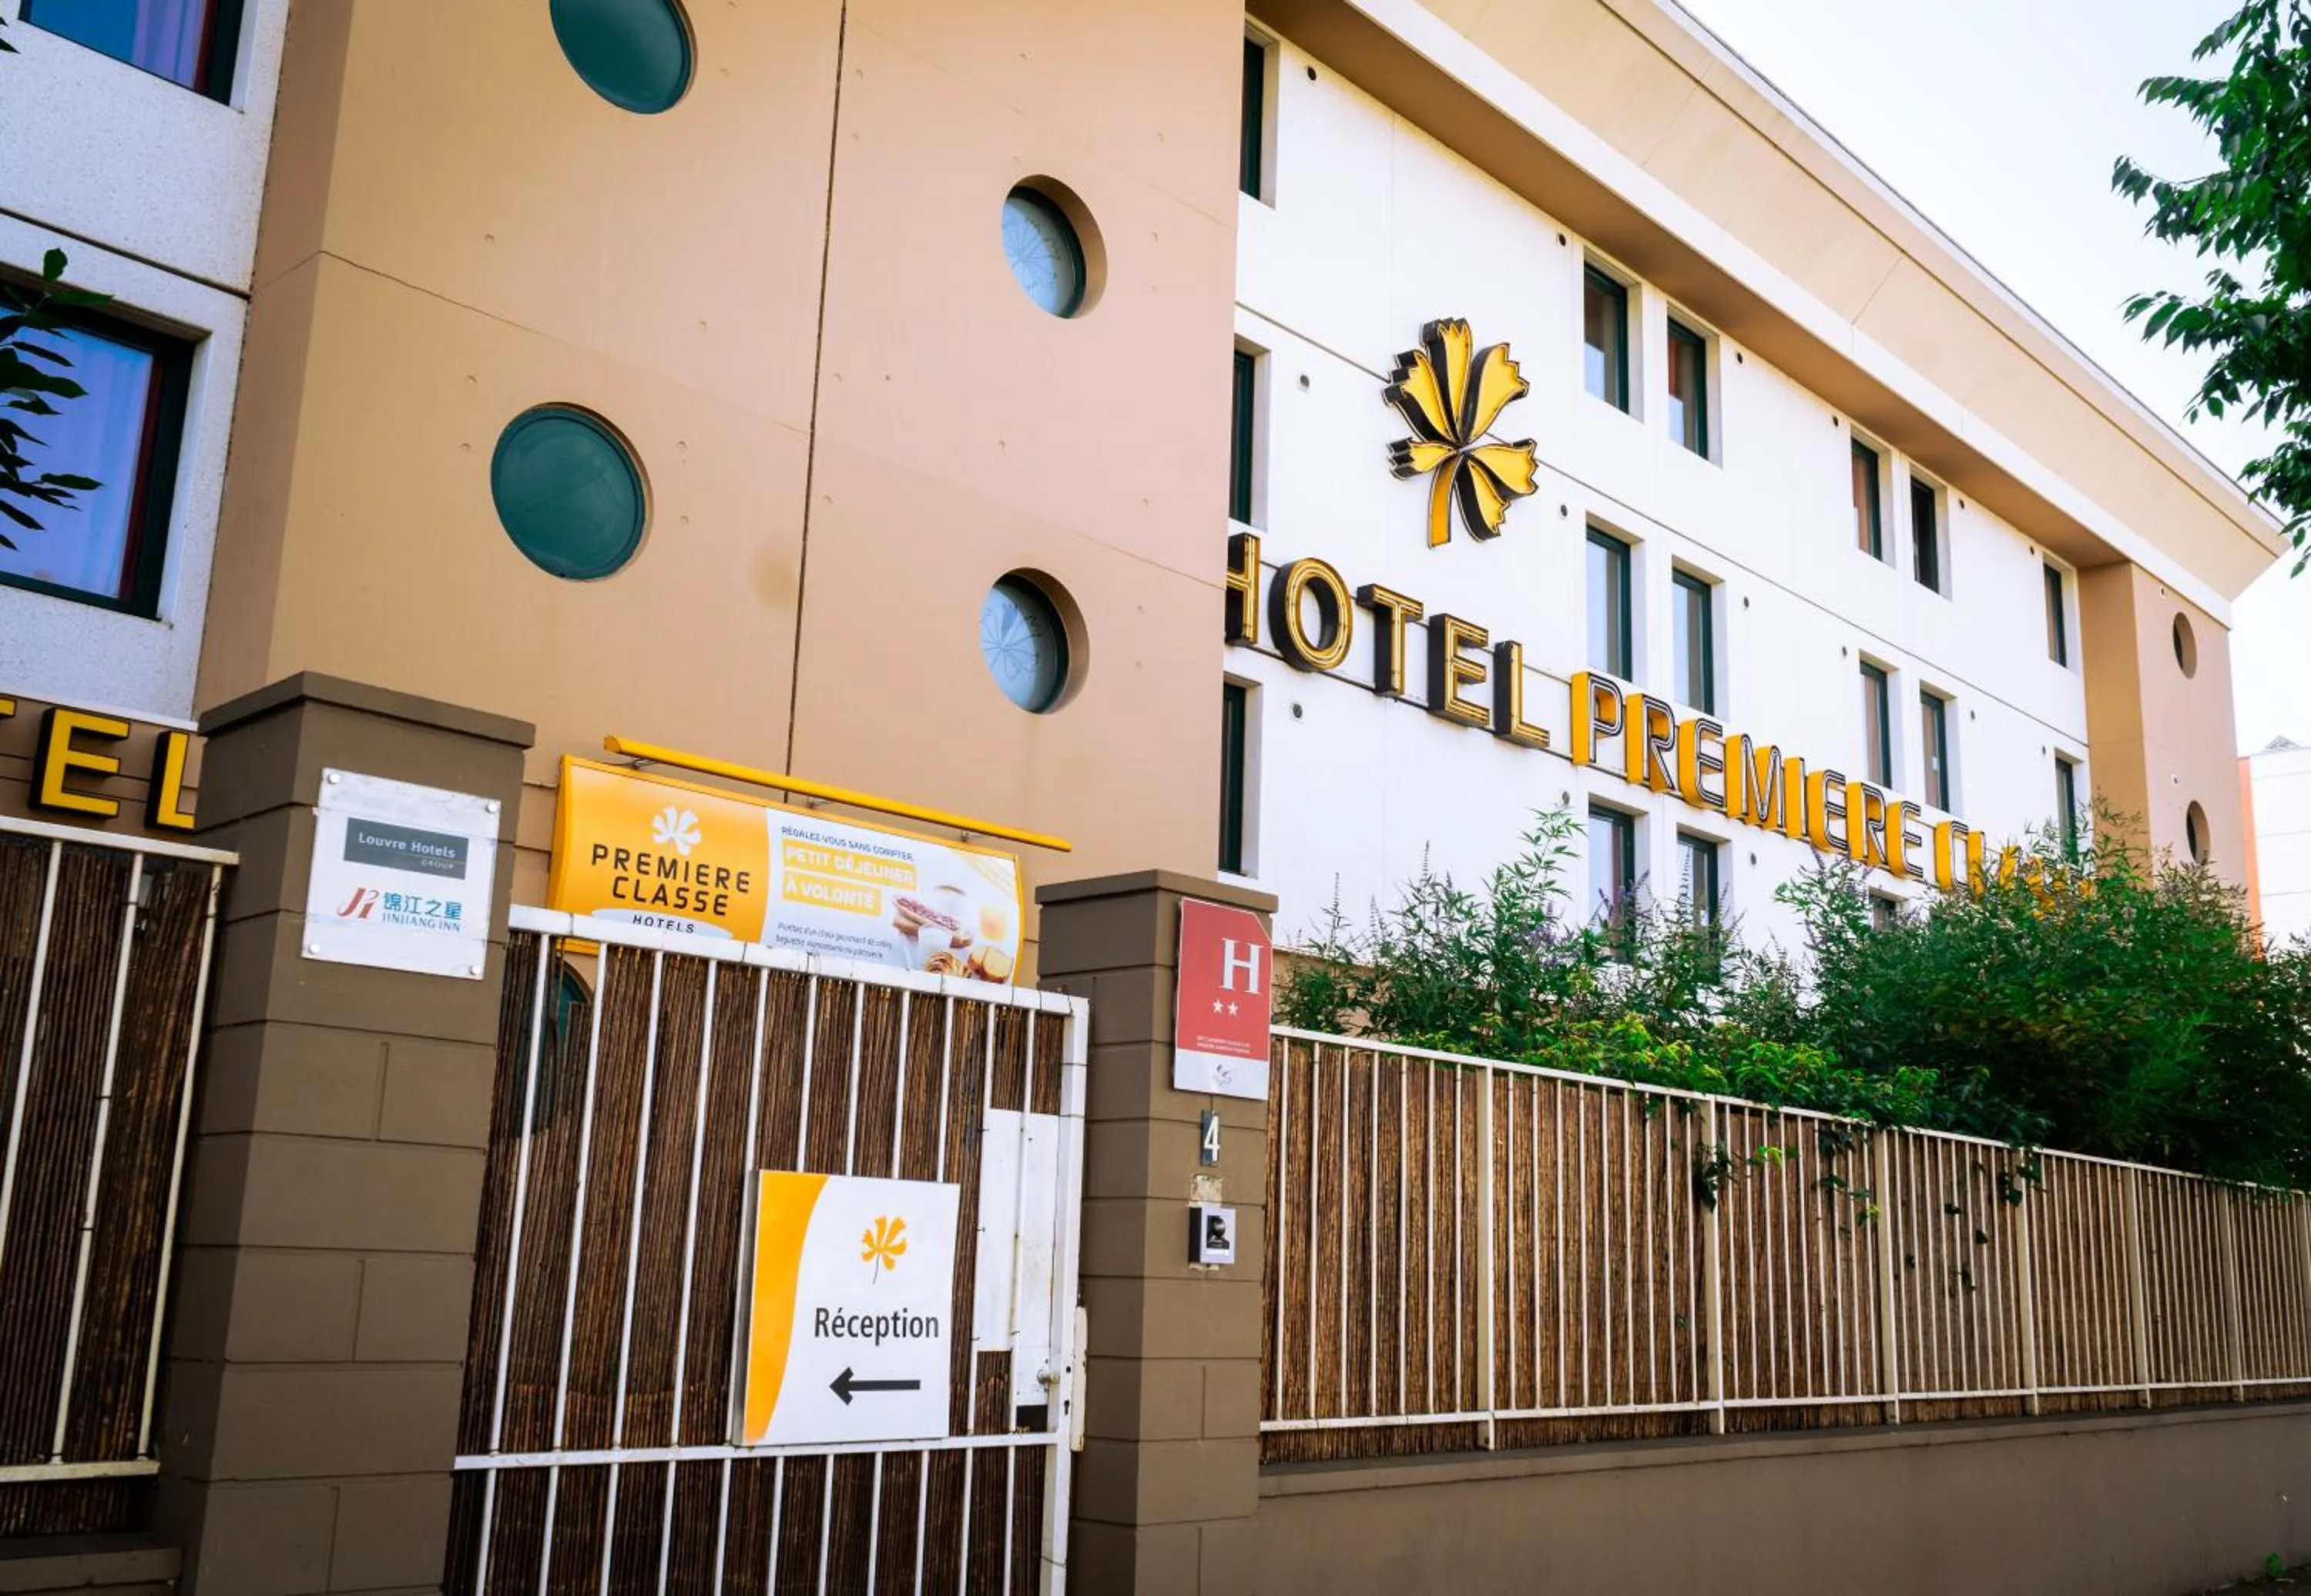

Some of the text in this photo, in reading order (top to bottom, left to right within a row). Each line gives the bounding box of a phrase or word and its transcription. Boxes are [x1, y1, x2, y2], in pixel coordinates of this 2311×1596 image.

[0, 698, 195, 833] EL
[1571, 672, 1924, 880] PREMIERE
[358, 832, 456, 859] Louvre Hotels
[421, 859, 454, 870] GROUP
[786, 845, 914, 884] PETIT DÉJEUNER
[848, 840, 871, 853] SANS
[592, 843, 750, 893] PREMIERE
[383, 891, 463, 921] 锦江之星
[612, 876, 729, 916] CLASSE
[801, 880, 874, 910] VOLONTÉ
[382, 912, 461, 933] JINJIANG INN
[632, 914, 694, 934] HOTELS
[1220, 937, 1264, 996] H
[1204, 1115, 1221, 1162] 4
[814, 1307, 939, 1346] Réception
